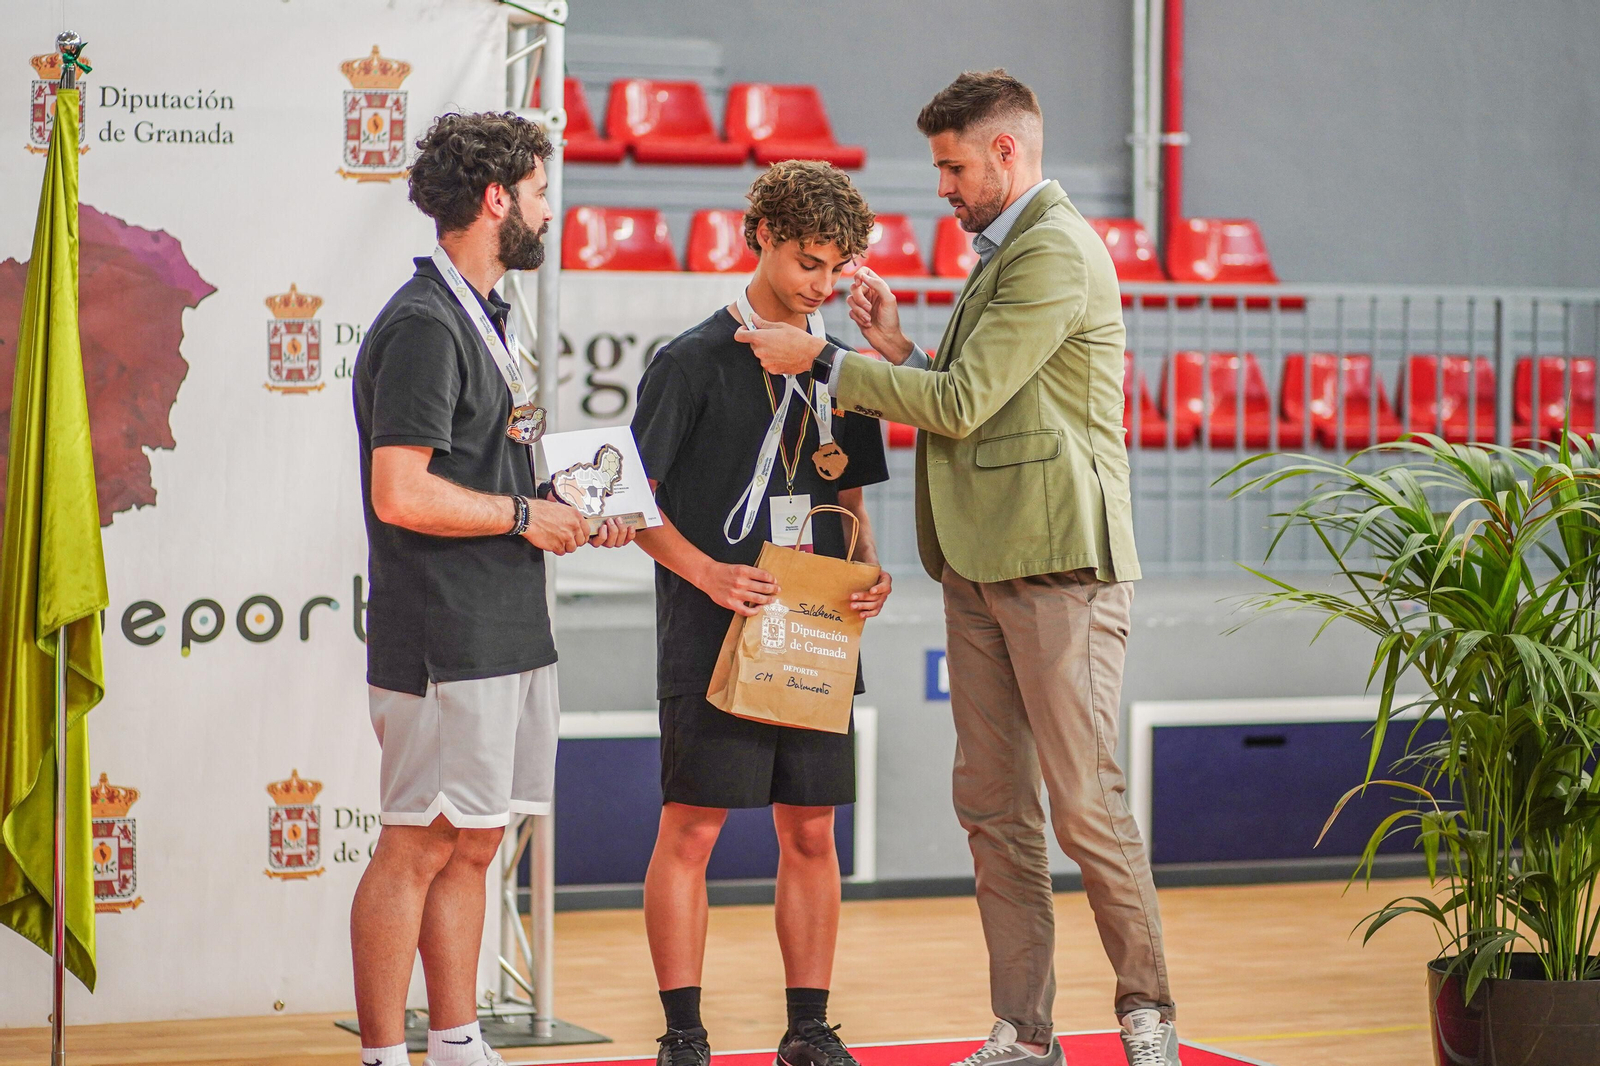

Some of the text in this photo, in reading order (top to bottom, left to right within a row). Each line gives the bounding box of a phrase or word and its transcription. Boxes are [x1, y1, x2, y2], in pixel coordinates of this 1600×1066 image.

[98, 86, 235, 114] Diputación
[98, 120, 235, 144] de Granada
[335, 323, 366, 345] Di
[101, 574, 368, 658] eport
[790, 621, 849, 643] Diputación
[789, 638, 847, 660] de Granada
[754, 672, 774, 682] CM
[783, 664, 819, 677] DEPORTES
[333, 841, 361, 863] de
